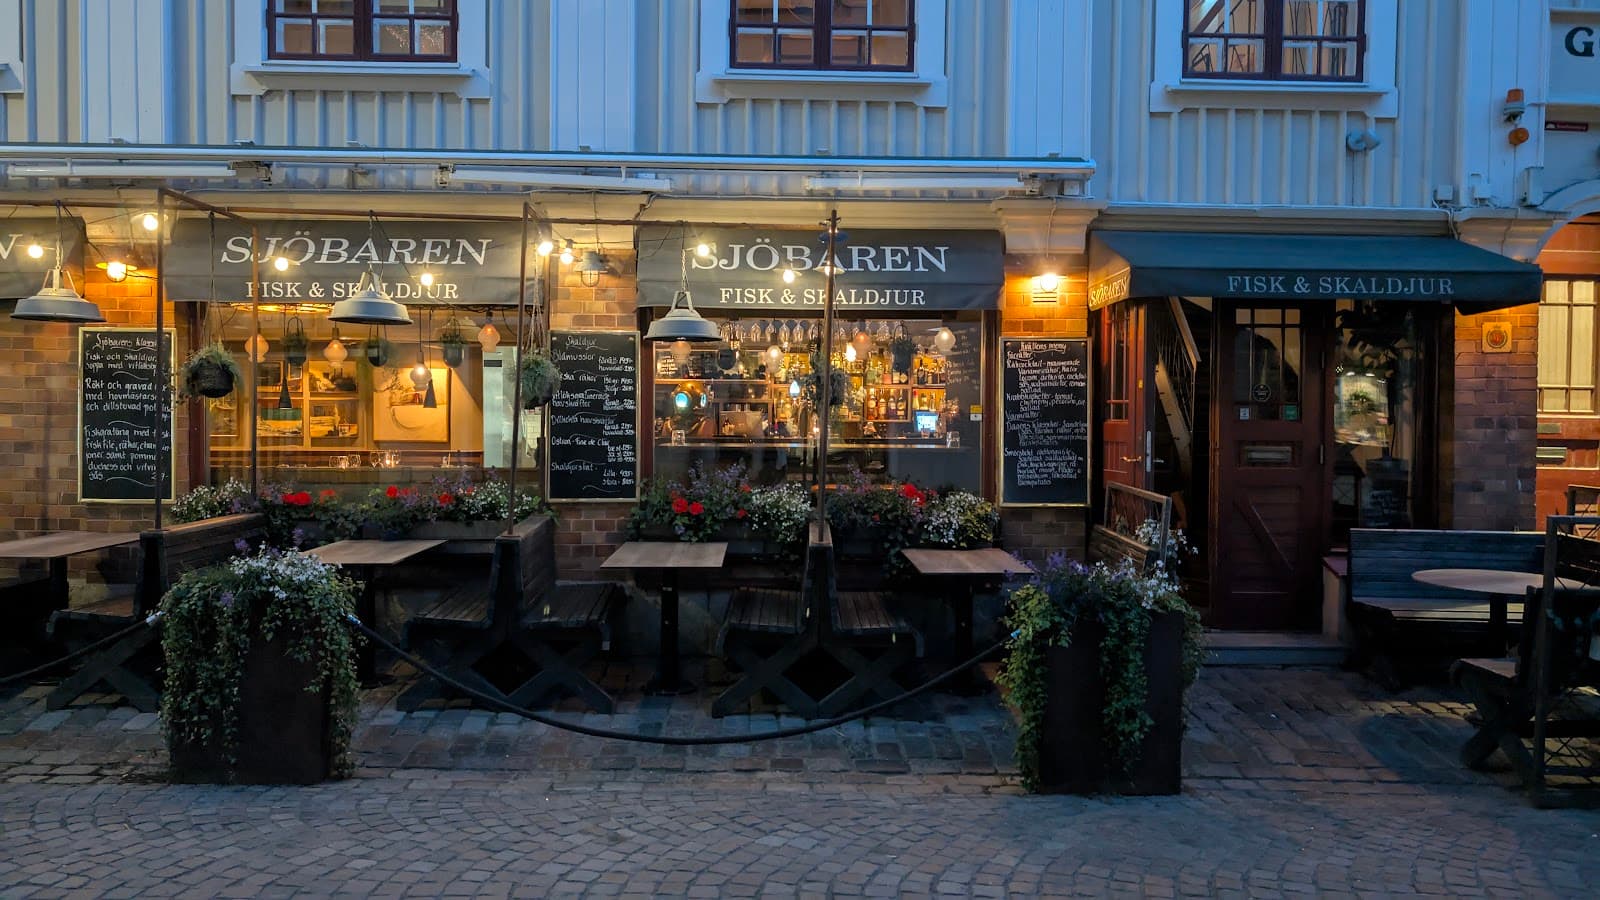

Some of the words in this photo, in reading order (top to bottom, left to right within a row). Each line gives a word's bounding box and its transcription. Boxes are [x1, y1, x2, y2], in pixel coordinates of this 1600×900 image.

[220, 230, 493, 265] SJÖBAREN
[691, 237, 950, 273] SJÖBAREN
[308, 282, 325, 298] &
[1227, 275, 1287, 293] FISK
[1293, 276, 1311, 294] &
[1319, 276, 1455, 295] SKALDJUR
[719, 288, 774, 305] FISK
[780, 288, 797, 304] &
[107, 381, 122, 390] och
[85, 392, 103, 401] med
[85, 402, 99, 411] och
[133, 428, 150, 437] med
